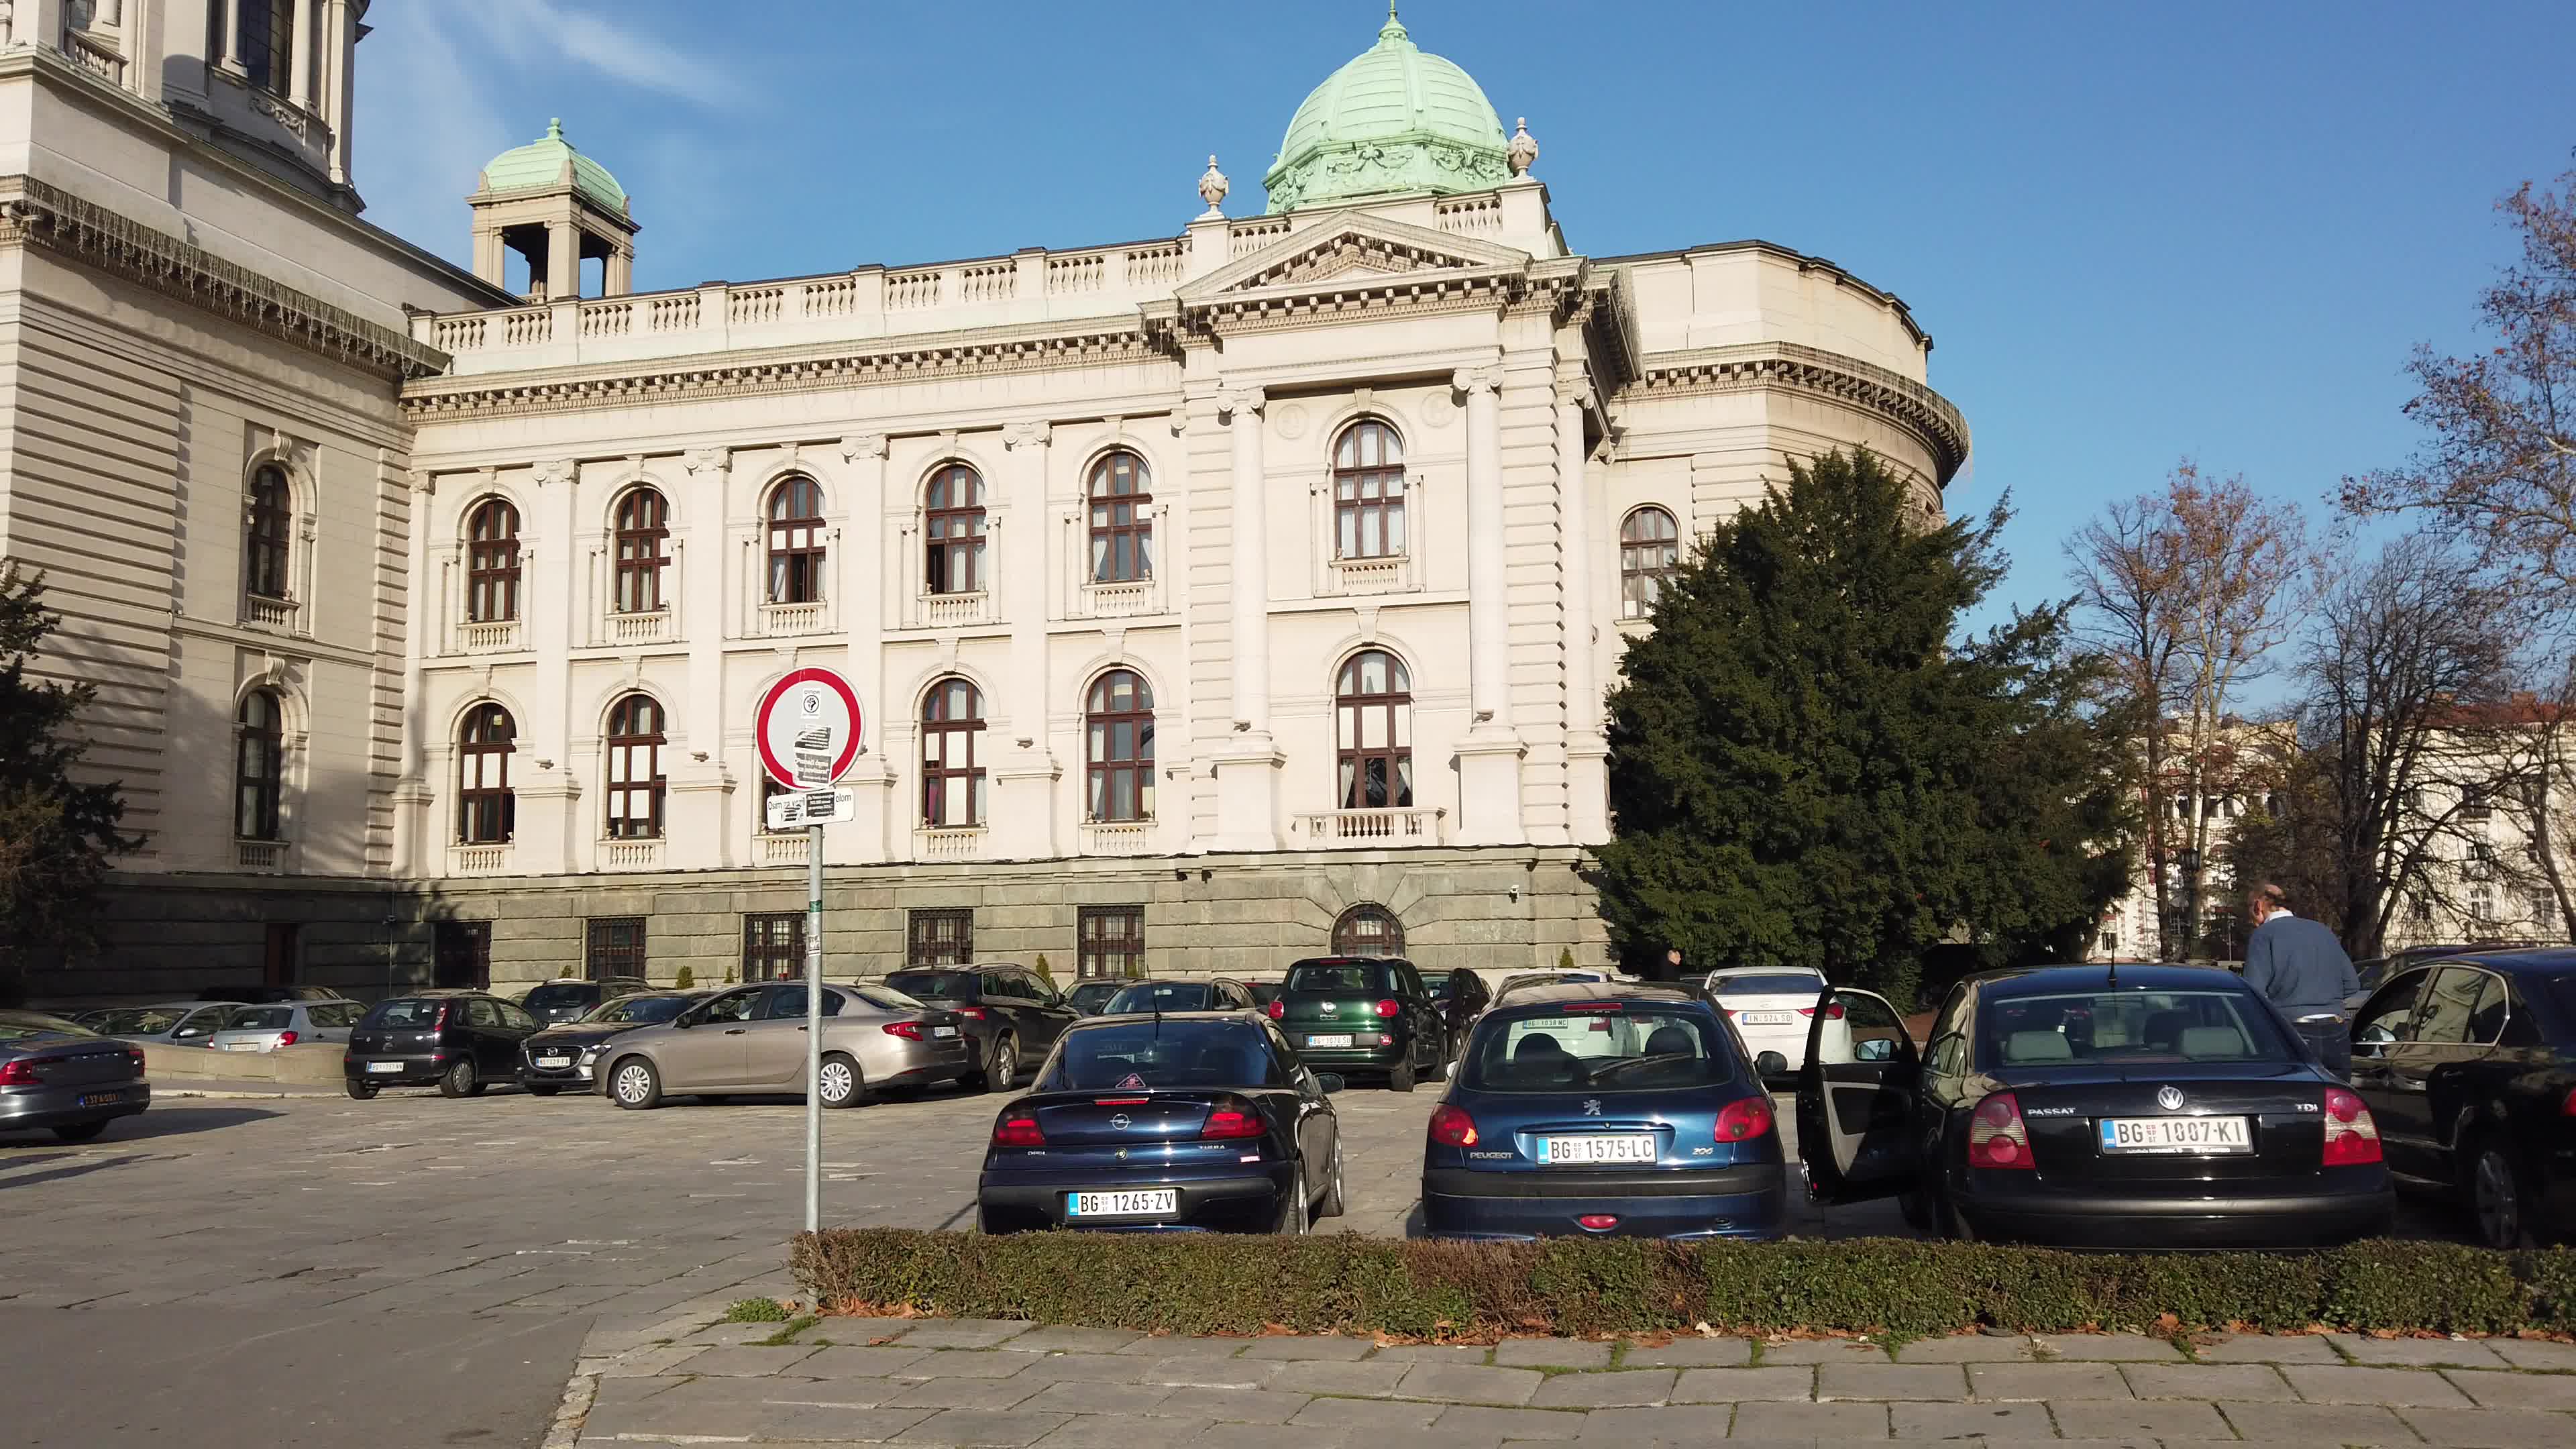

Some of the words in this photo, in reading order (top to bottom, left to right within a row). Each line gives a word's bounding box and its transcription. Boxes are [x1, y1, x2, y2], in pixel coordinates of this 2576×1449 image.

[2028, 1108, 2076, 1116] PASSAT
[2117, 1123, 2143, 1143] BG
[1551, 1141, 1570, 1159] BG
[1081, 1195, 1099, 1212] BG
